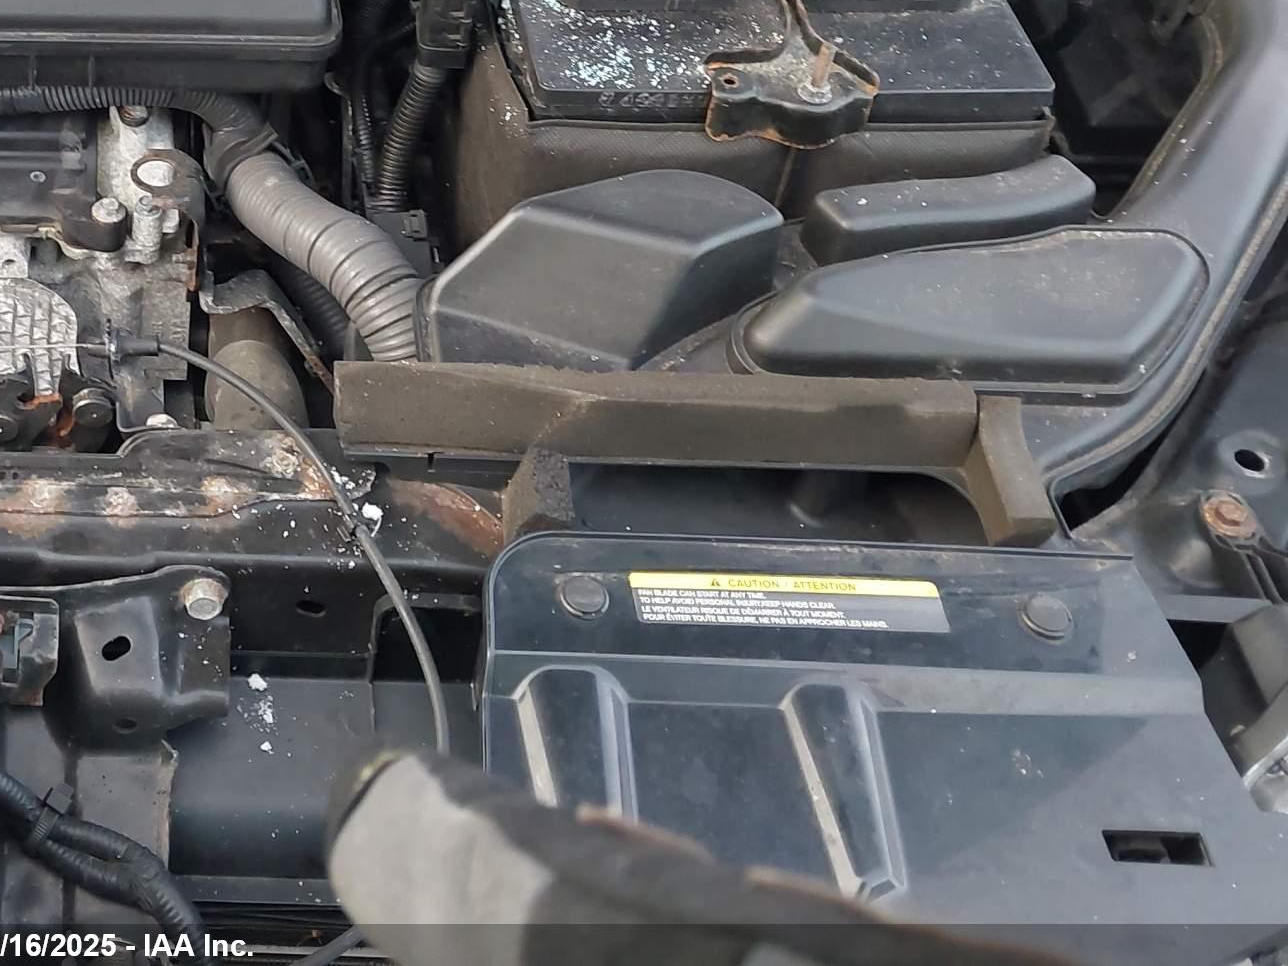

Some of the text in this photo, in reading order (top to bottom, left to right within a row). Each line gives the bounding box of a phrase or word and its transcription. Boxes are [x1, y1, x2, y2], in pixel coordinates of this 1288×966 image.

[728, 579, 780, 587] CAUTION
[794, 582, 856, 591] ATTENTION
[696, 598, 734, 606] PERSONAL
